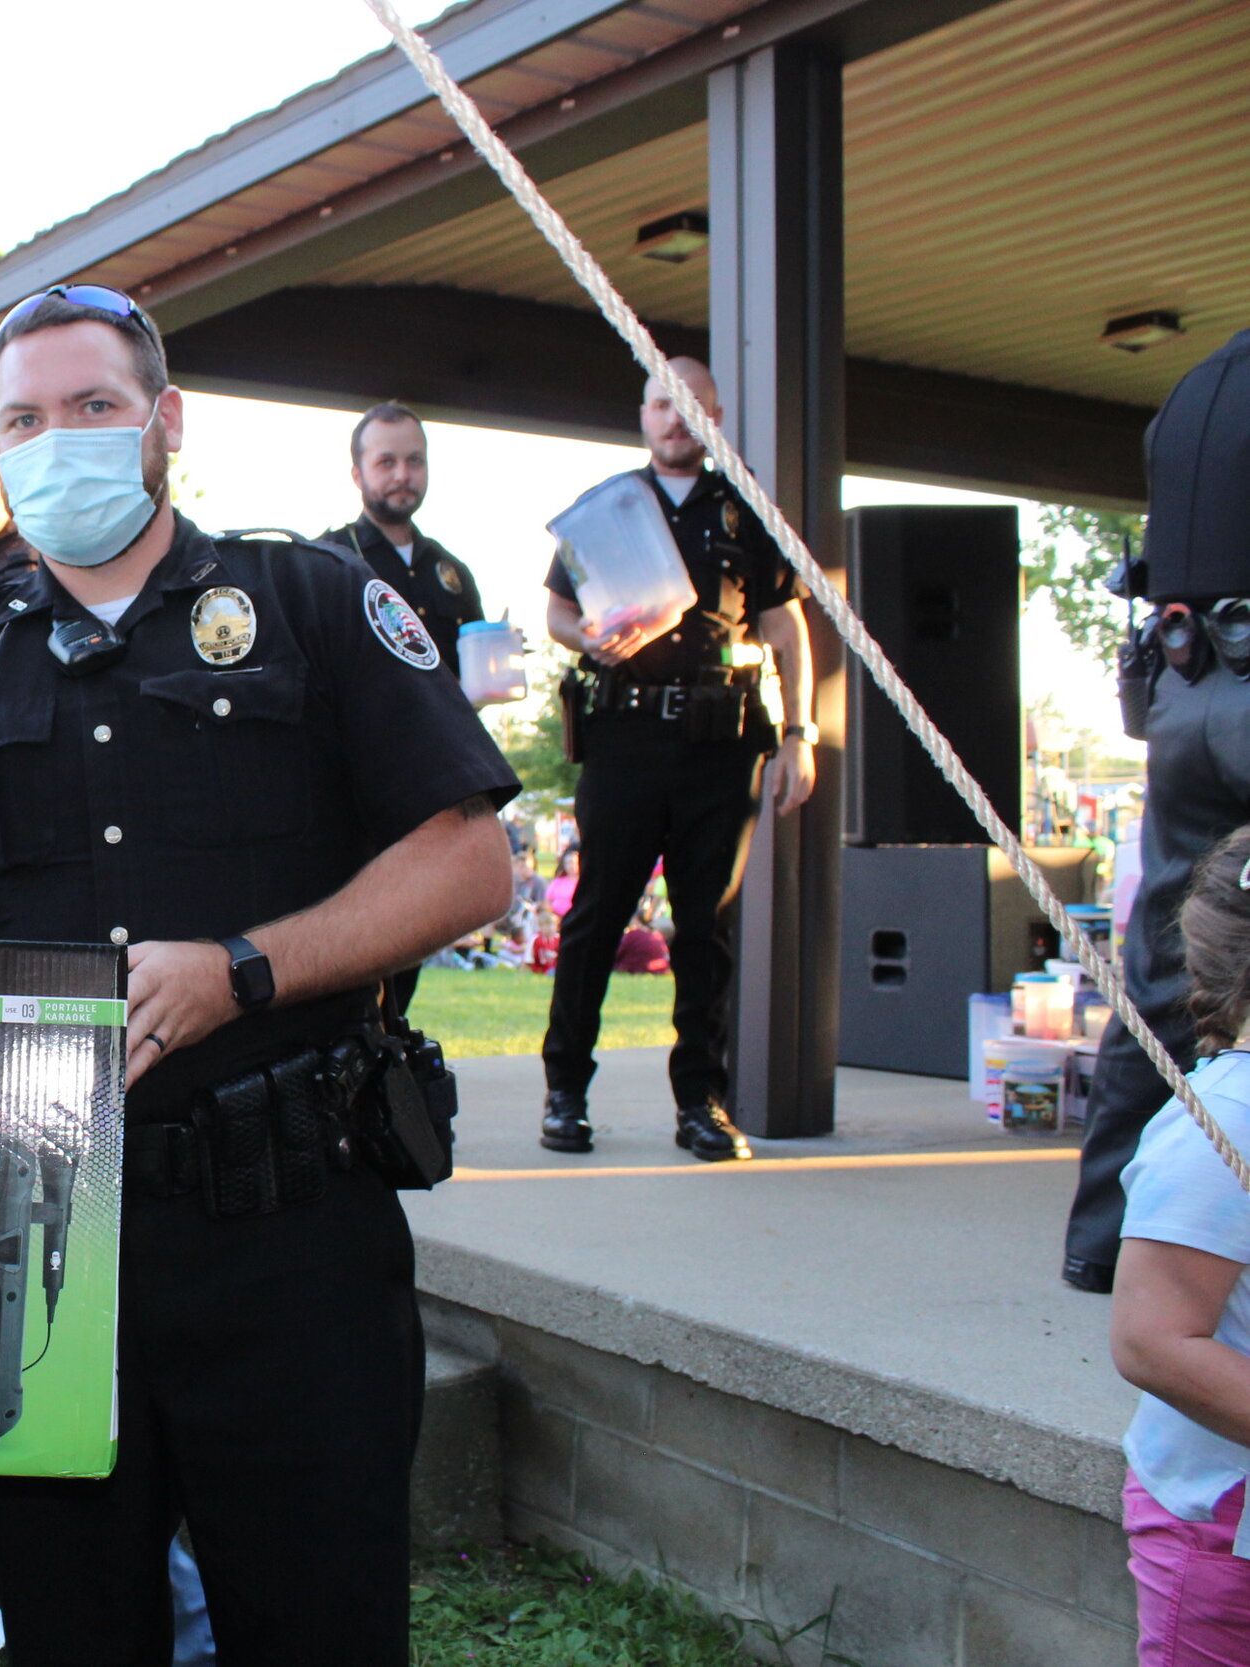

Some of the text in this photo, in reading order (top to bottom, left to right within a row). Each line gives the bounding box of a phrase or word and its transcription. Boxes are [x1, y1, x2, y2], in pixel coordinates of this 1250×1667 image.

[22, 1003, 35, 1018] 03
[45, 1003, 97, 1013] PORTABLE
[45, 1013, 92, 1022] KARAOKE
